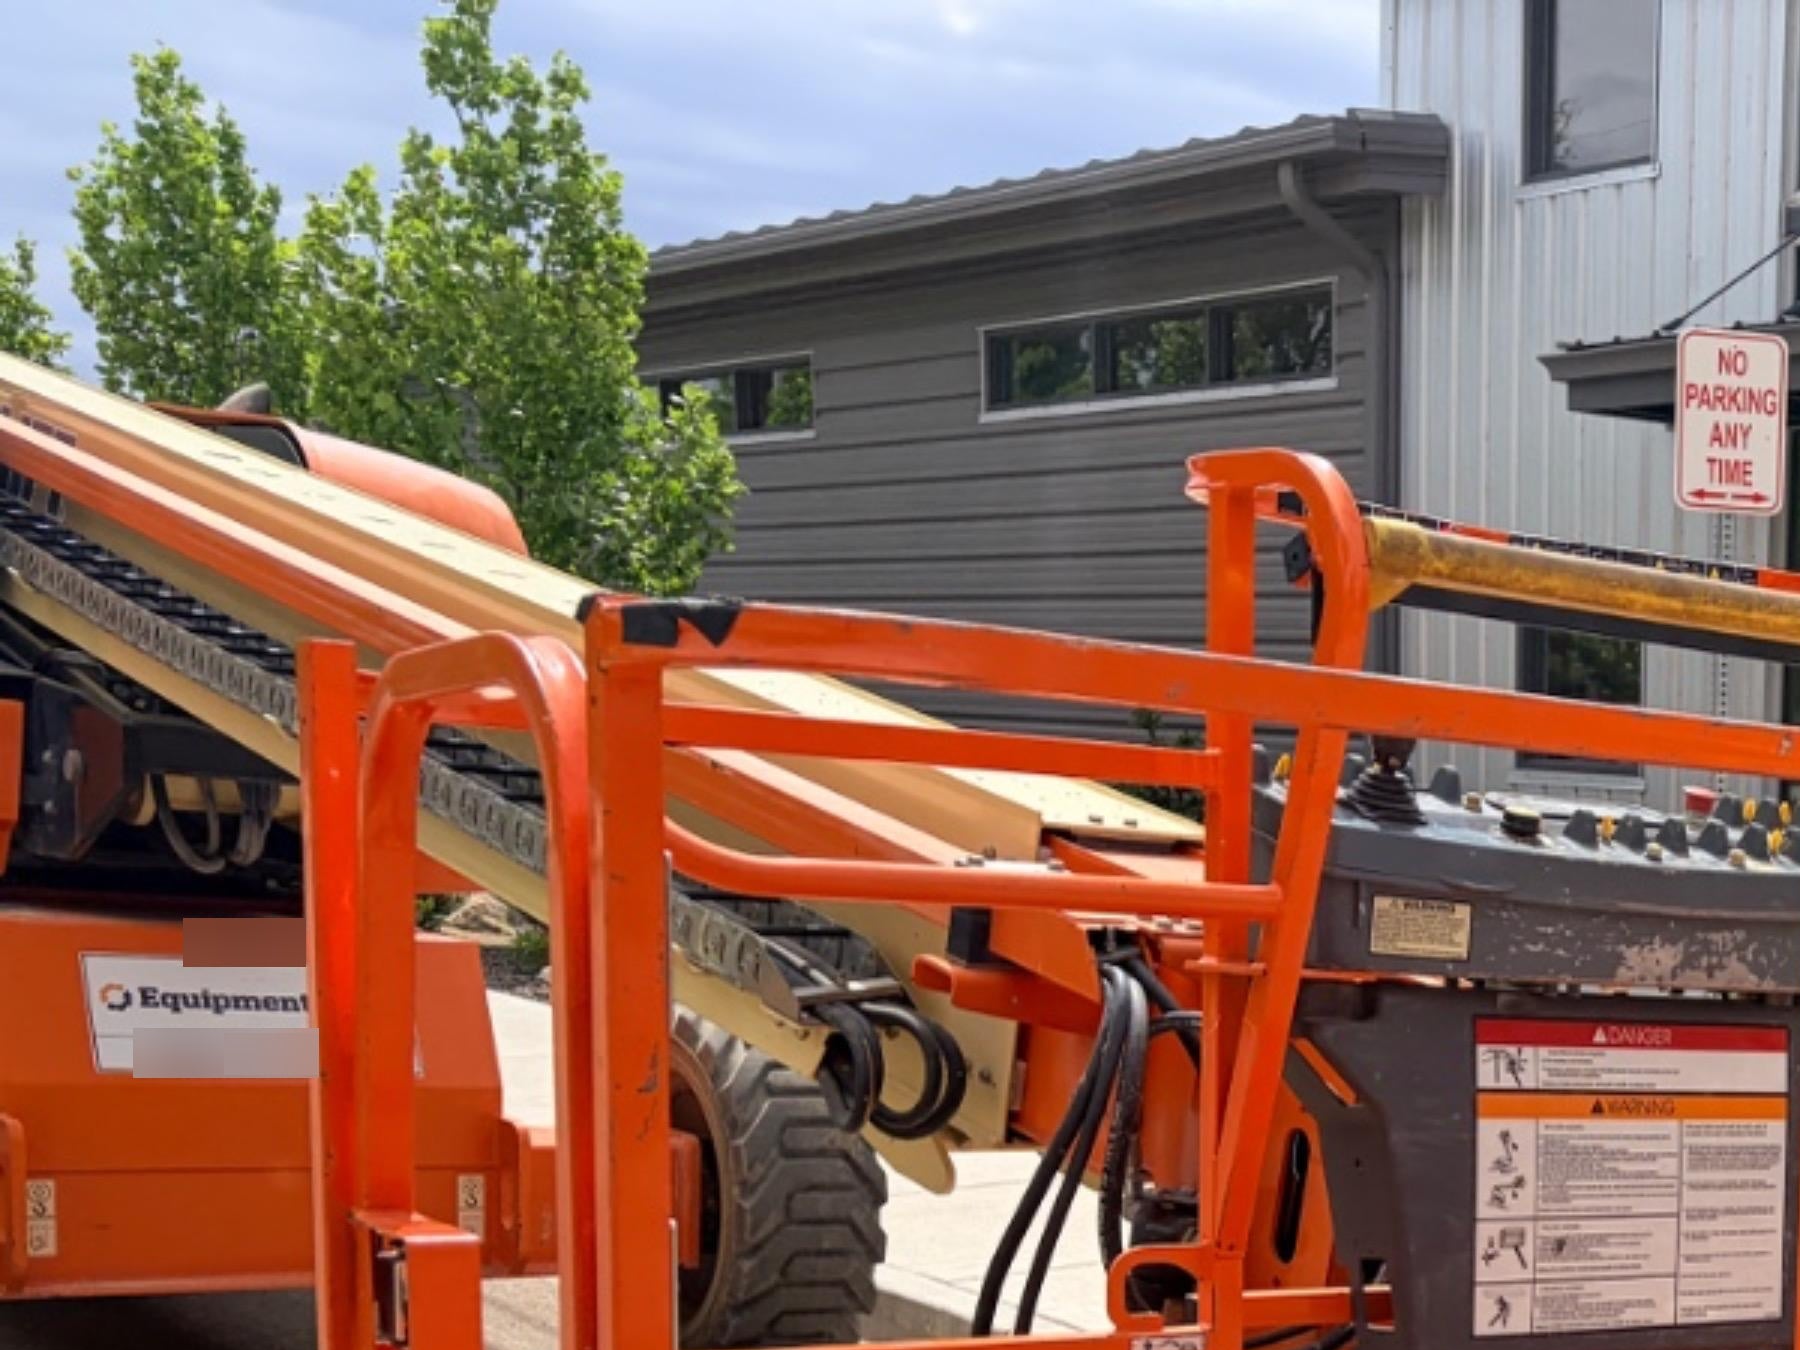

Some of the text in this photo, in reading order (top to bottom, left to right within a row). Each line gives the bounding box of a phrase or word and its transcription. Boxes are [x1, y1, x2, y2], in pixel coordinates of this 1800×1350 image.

[1717, 347, 1748, 376] NO
[1685, 383, 1777, 415] PARKING
[1709, 421, 1752, 450] ANY
[1706, 458, 1753, 486] TIME
[1606, 1026, 1673, 1045] DANGER
[1605, 1097, 1675, 1116] WARNING
